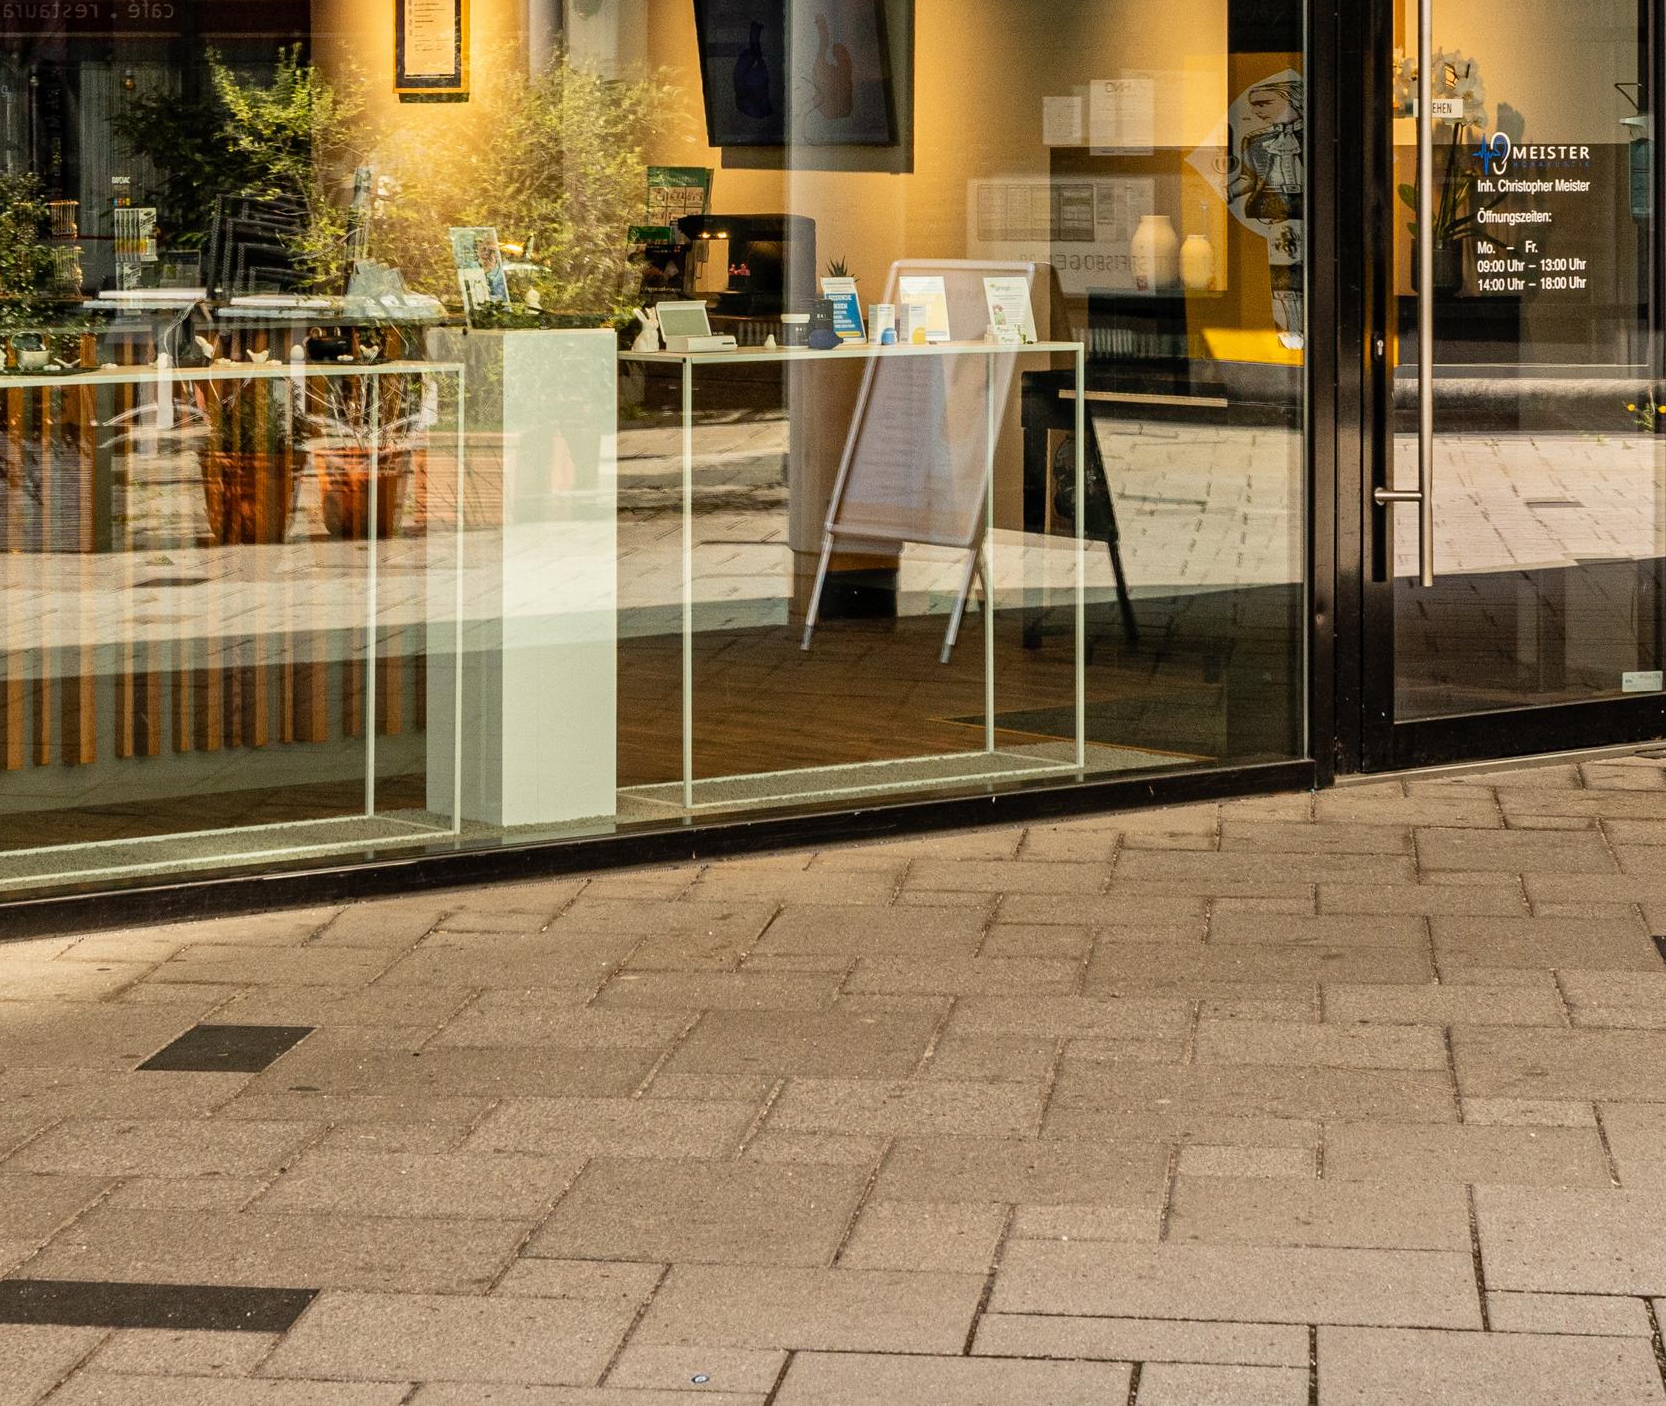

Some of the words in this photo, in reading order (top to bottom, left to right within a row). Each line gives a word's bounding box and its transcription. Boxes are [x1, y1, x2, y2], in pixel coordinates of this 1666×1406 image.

[1513, 146, 1590, 160] MEISTER
[1477, 179, 1496, 193] Inh.
[1498, 179, 1553, 194] Christopher
[1555, 178, 1590, 193] Meister
[1477, 207, 1552, 226] Öffnungszeiten:
[1477, 241, 1496, 255] Mo.
[1525, 240, 1539, 254] Fr.
[1477, 260, 1505, 273] 09:00
[1507, 259, 1525, 273] Uhr
[1540, 258, 1567, 272] 13:00
[1569, 258, 1587, 271] Uhr
[1477, 278, 1505, 292] 14:00
[1507, 278, 1525, 292] Uhr
[1540, 277, 1567, 290] 18:00
[1569, 276, 1587, 290] Uhr
